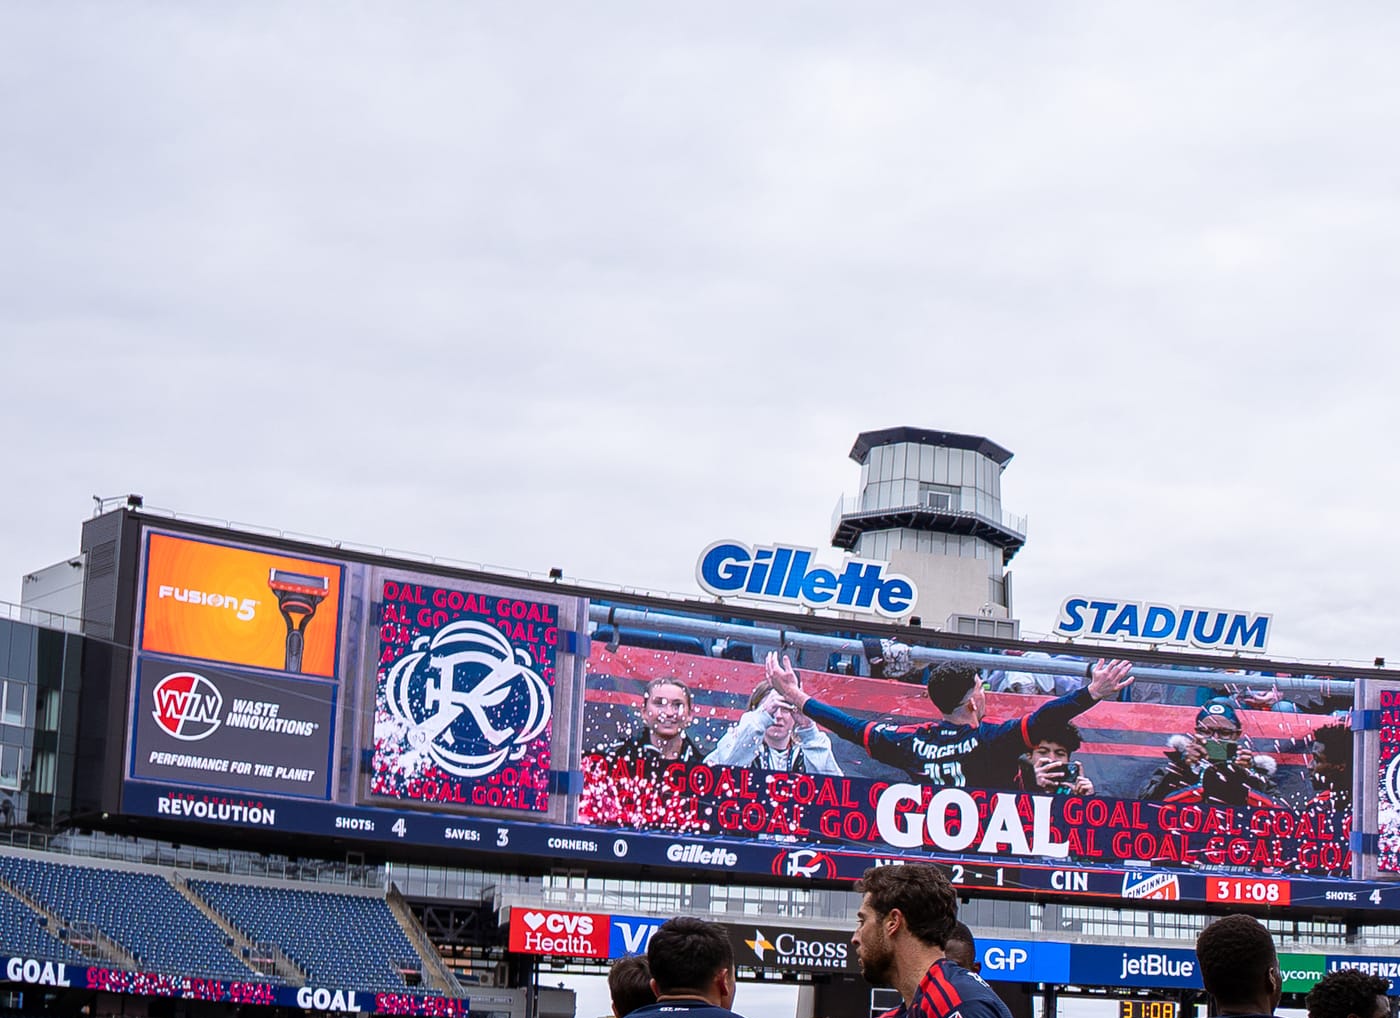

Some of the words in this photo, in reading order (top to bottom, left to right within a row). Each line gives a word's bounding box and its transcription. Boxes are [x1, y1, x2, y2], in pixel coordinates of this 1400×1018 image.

[702, 544, 912, 612] Gillette
[432, 588, 491, 615] GOAL
[496, 598, 554, 624] GOAL
[1059, 599, 1269, 648] STADIUM
[232, 698, 279, 718] WASTE
[149, 751, 228, 772] PERFORMANCE
[230, 761, 251, 775] FOR
[253, 764, 274, 778] THE
[275, 767, 315, 782] PLANET
[158, 797, 276, 825] REVOLUTION
[471, 786, 530, 810] GOAL
[665, 762, 758, 799] GOAL
[767, 773, 859, 809] GOAL
[1063, 797, 1149, 830] GOAL
[1158, 804, 1242, 835] GOAL
[717, 799, 810, 836] GOAL
[1111, 830, 1198, 862] GOAL
[876, 782, 1070, 858] GOAL
[335, 816, 375, 831] SHOTS:
[391, 818, 407, 838] 4
[444, 828, 481, 842] SAVES:
[496, 828, 509, 847] 3
[547, 837, 598, 852] CORNERS:
[613, 838, 628, 858] 0
[666, 843, 738, 866] Gillette
[951, 863, 965, 884] 2
[996, 867, 1004, 886] 1
[1050, 869, 1089, 891] CIN
[1217, 880, 1279, 901] 31:08
[1325, 889, 1357, 901] SHOTS:
[1369, 889, 1382, 905] 4
[547, 913, 594, 936] CVS
[524, 931, 593, 955] Health
[6, 957, 71, 988] GOAL
[777, 955, 848, 969] INSURANCE
[1120, 953, 1193, 980] jetBlue
[1281, 970, 1321, 981] ycom
[296, 986, 361, 1013] GOAL
